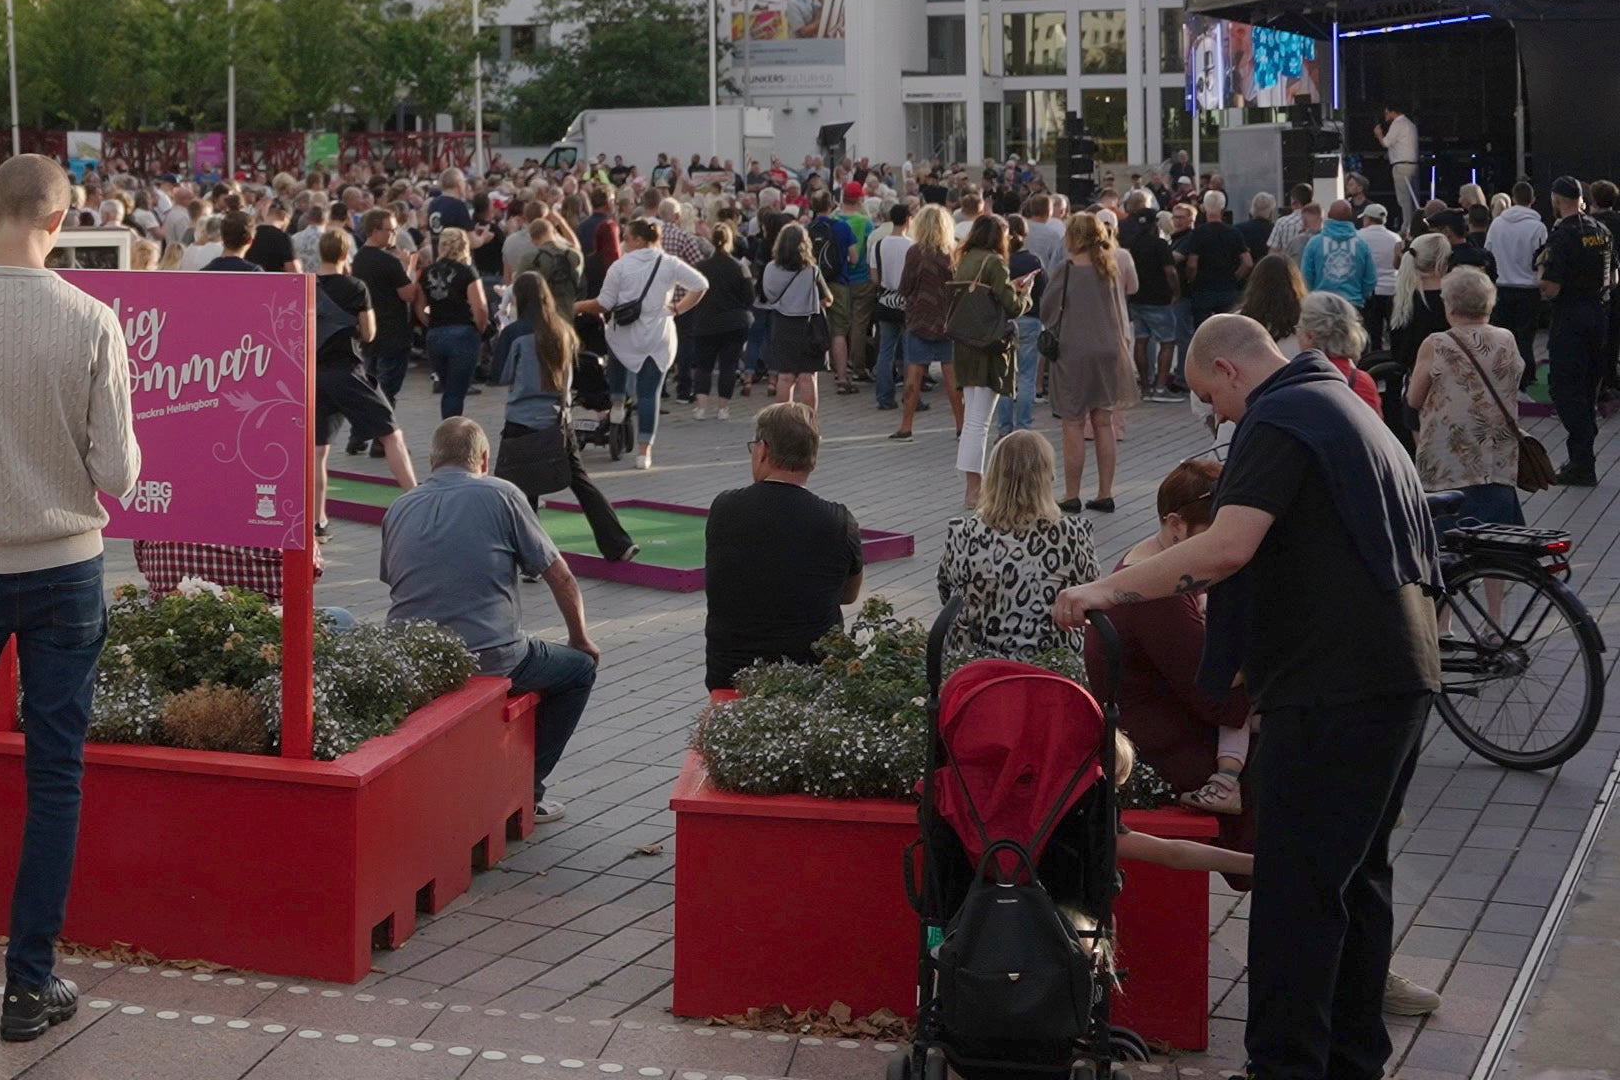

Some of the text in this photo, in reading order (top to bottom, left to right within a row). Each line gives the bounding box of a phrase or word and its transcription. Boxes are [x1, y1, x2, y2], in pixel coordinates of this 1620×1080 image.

[136, 397, 219, 421] vackra Helsingborg
[137, 480, 172, 498] HBG
[134, 496, 172, 514] CITY
